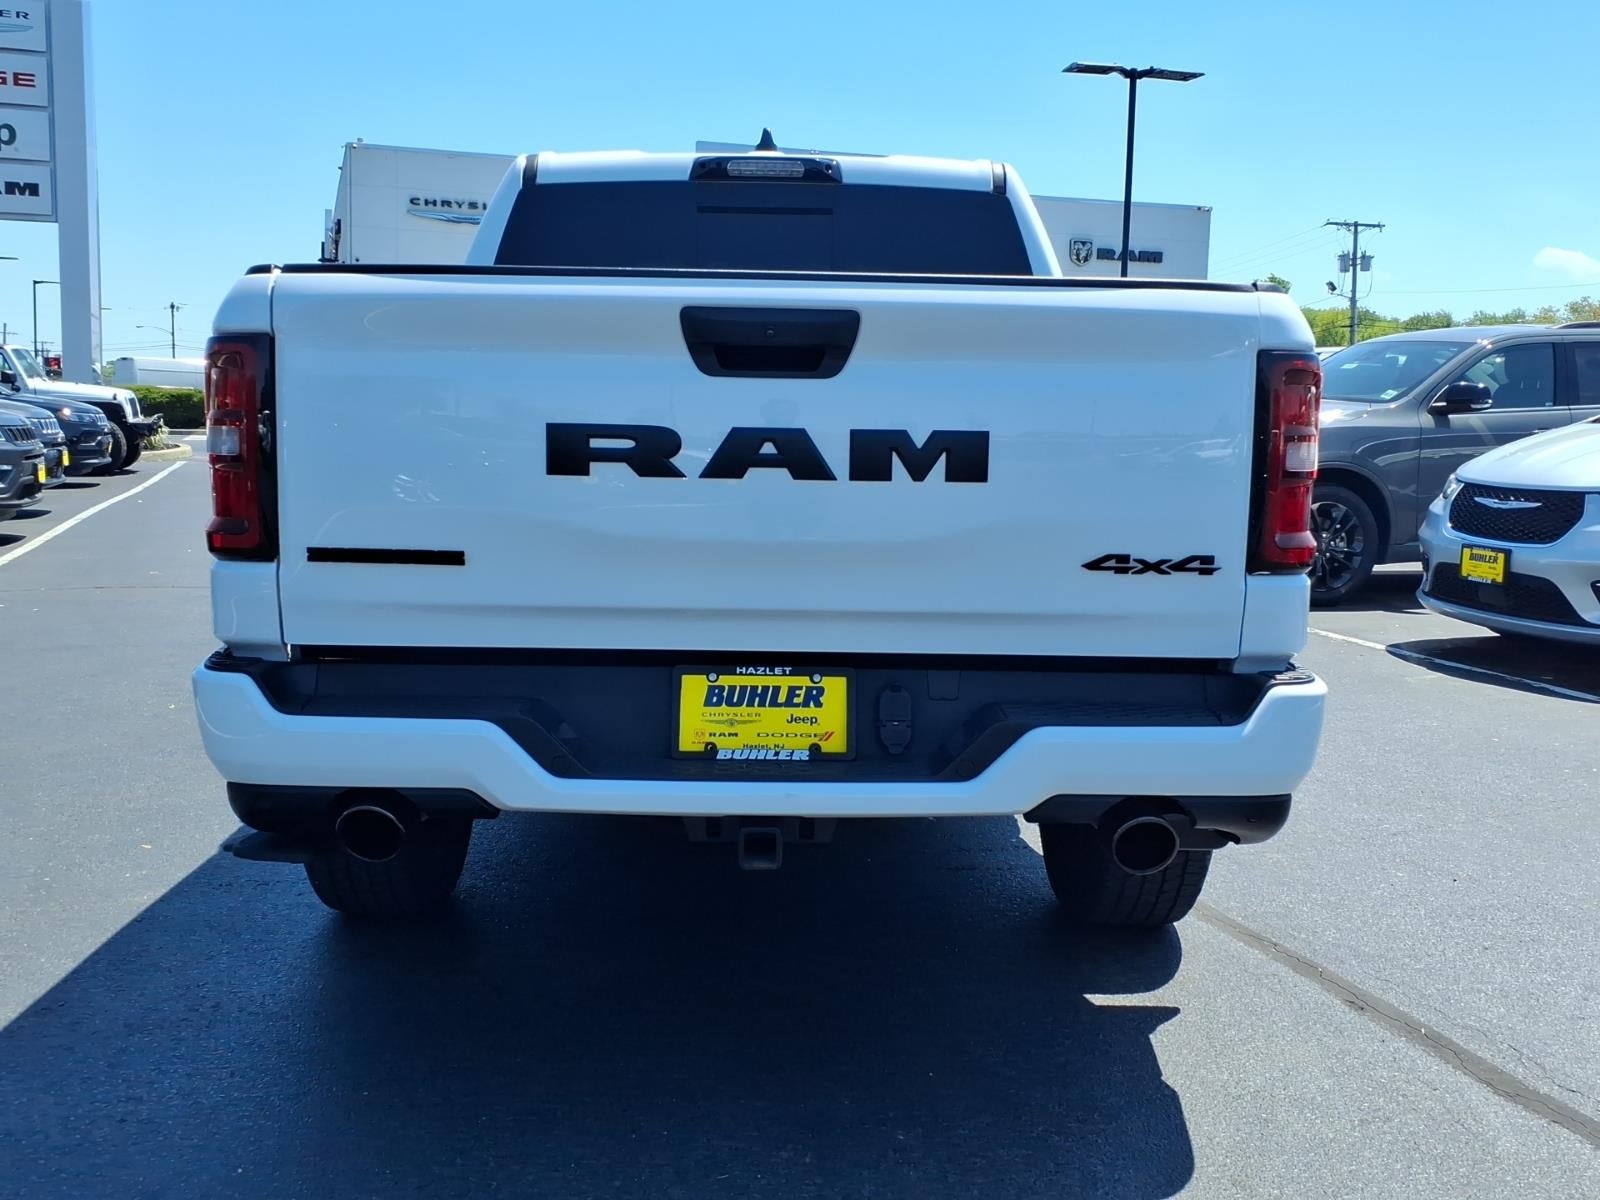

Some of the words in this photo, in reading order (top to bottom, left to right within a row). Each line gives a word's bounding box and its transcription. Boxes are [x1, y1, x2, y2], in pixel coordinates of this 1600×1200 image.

[546, 422, 990, 483] RAM
[1080, 553, 1222, 576] 4x4
[736, 666, 792, 675] HAZLET
[704, 685, 824, 708] BUHLER
[786, 713, 819, 727] Jeep
[716, 749, 810, 760] BUHLER
